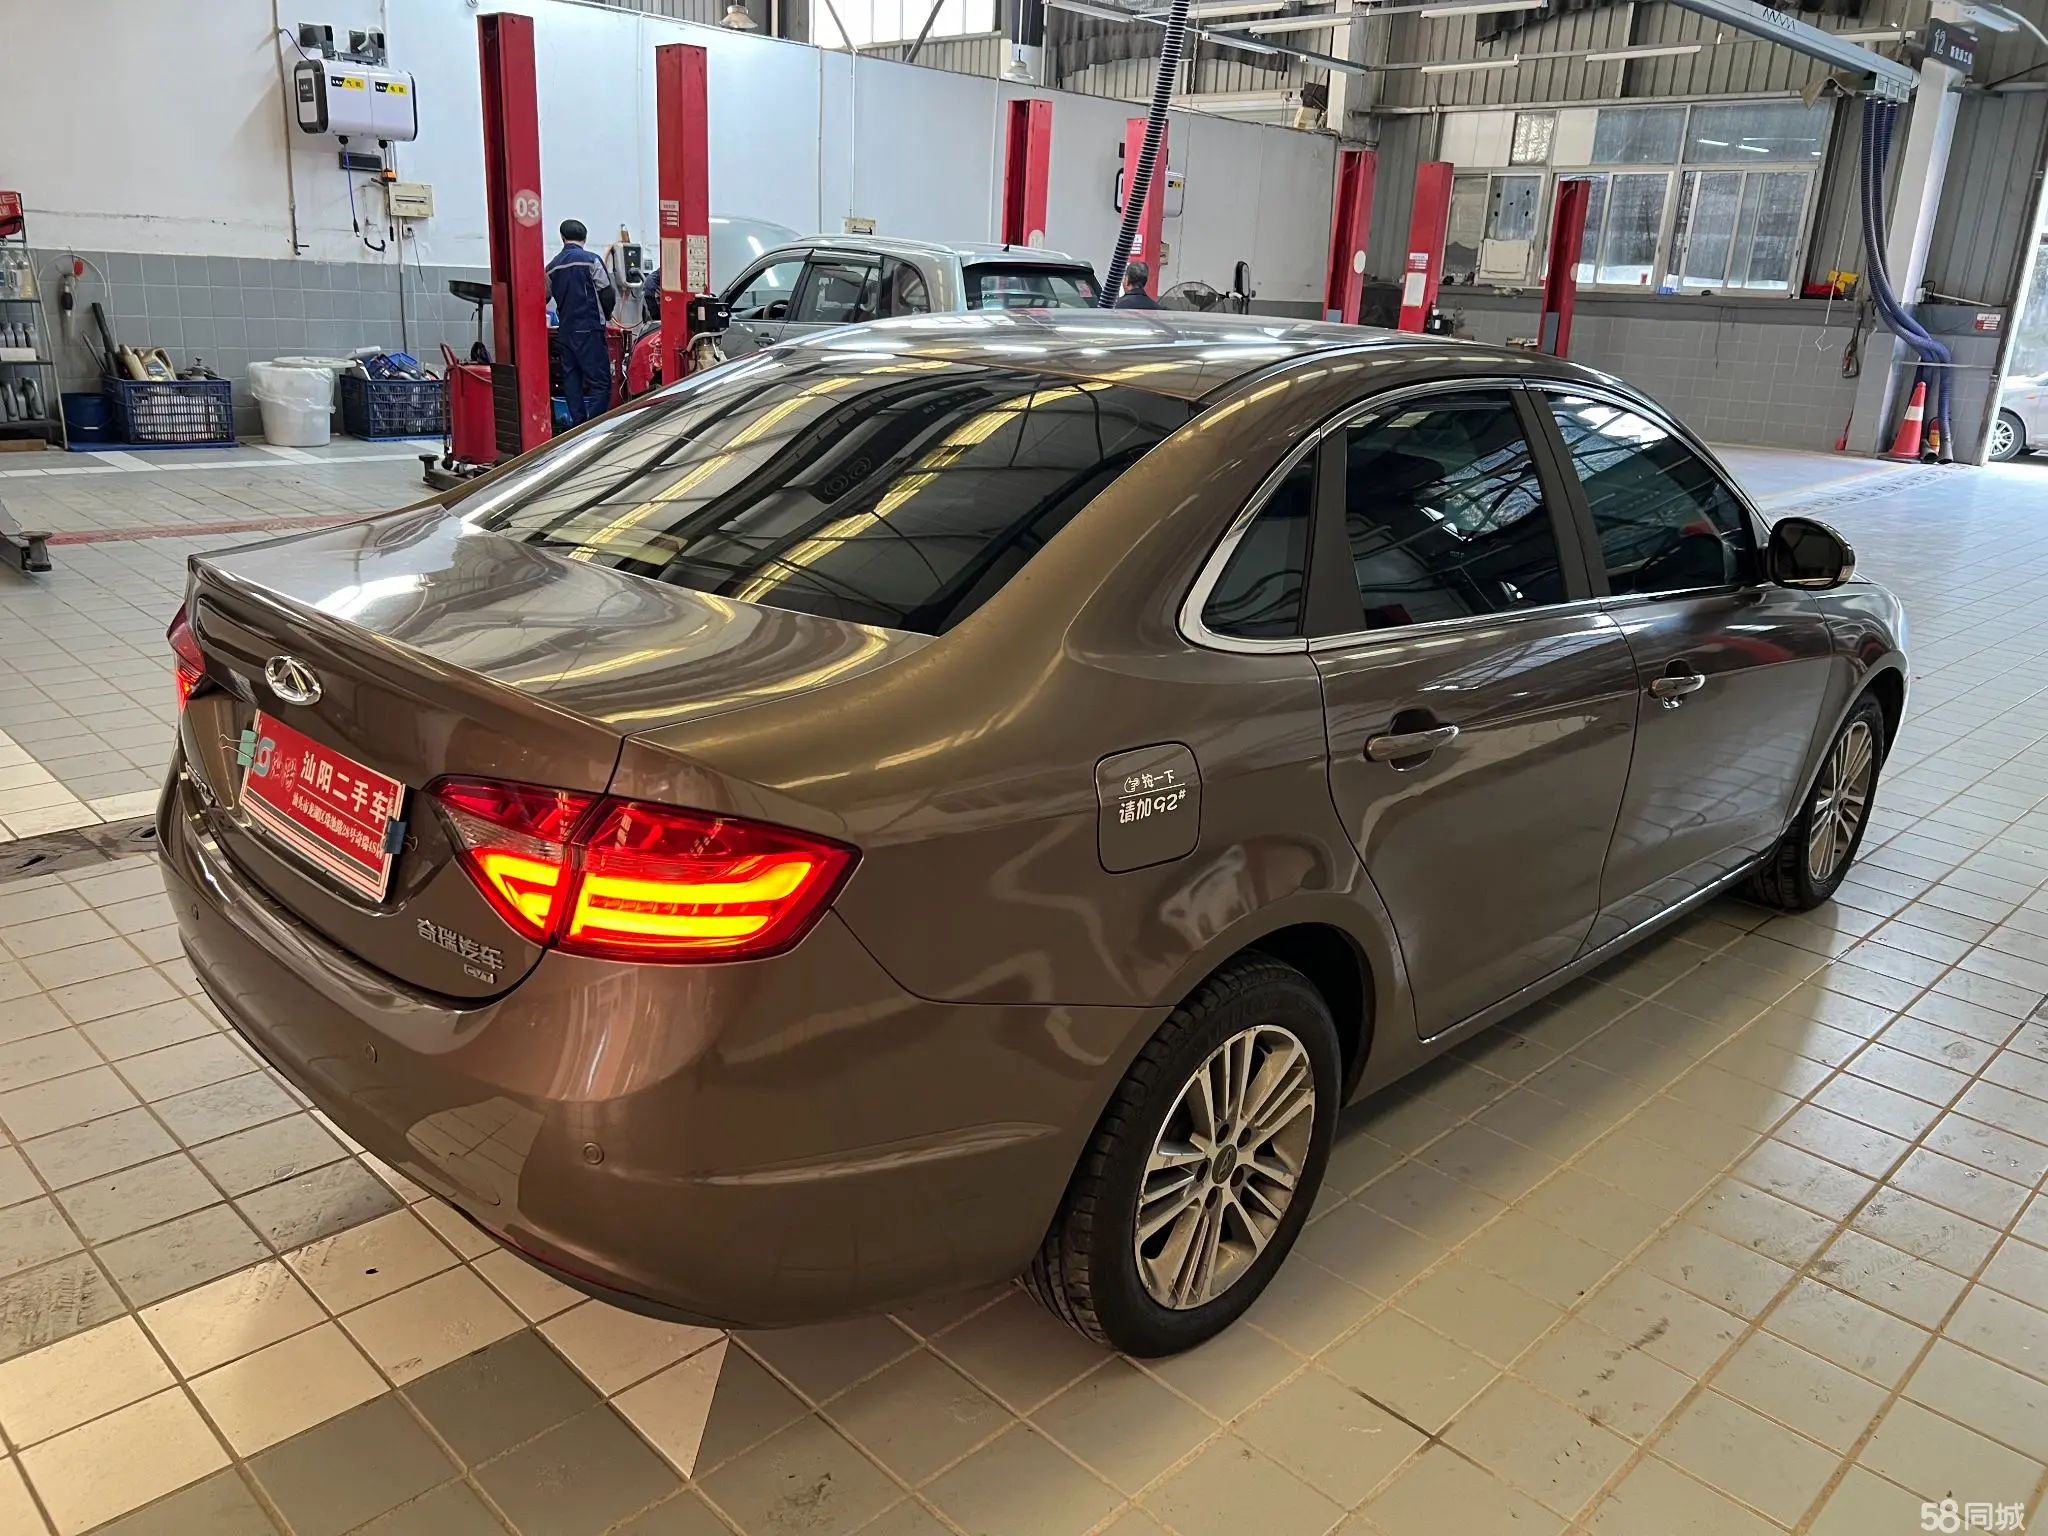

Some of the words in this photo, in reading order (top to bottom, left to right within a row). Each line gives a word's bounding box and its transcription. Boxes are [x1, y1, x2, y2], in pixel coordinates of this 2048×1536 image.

[1933, 28, 1947, 55] 12
[515, 196, 540, 218] 03
[300, 750, 388, 824] 汕阳二手车
[1141, 769, 1175, 789] 按一下
[416, 917, 504, 970] 奇瑞汽车
[463, 962, 495, 985] CVT
